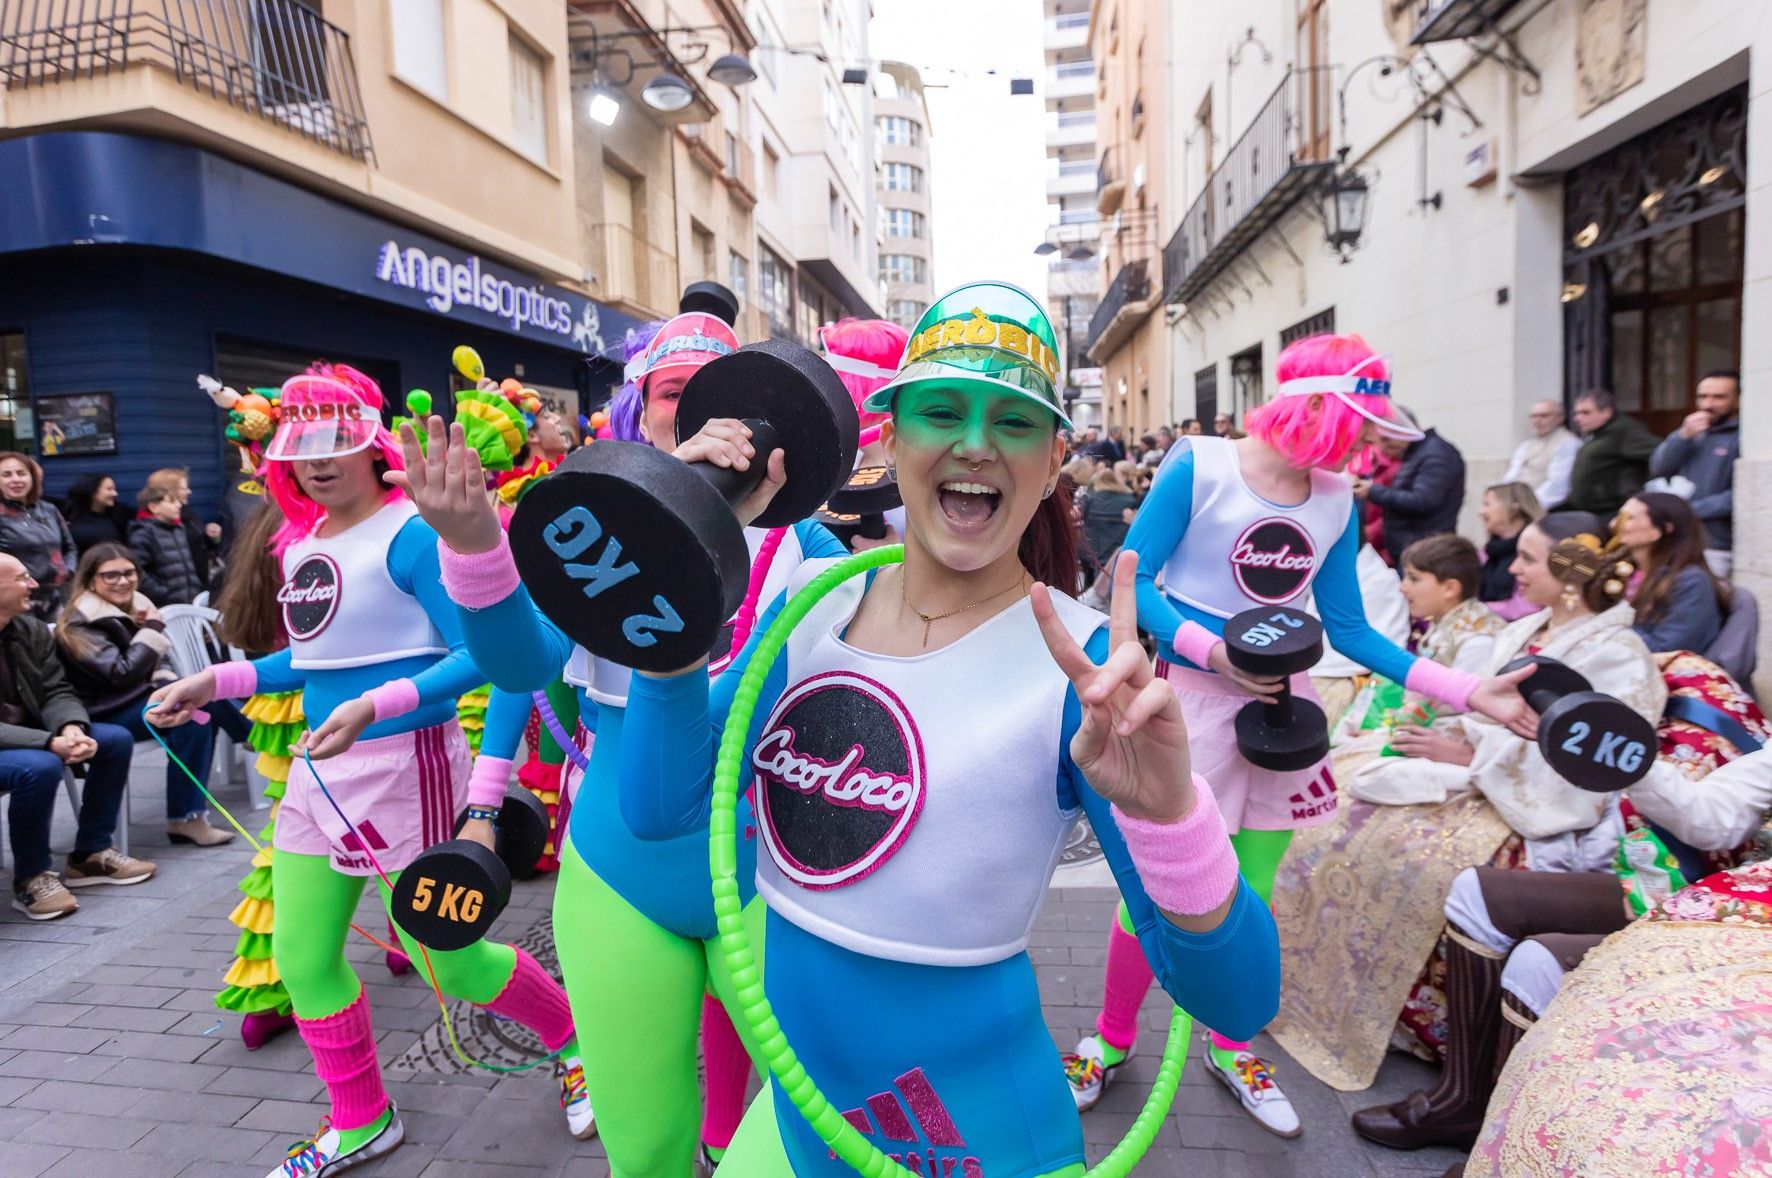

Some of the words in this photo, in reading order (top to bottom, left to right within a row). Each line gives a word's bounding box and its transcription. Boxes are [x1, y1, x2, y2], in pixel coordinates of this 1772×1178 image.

[542, 505, 641, 599] KG
[622, 594, 685, 648] 2
[1240, 622, 1287, 647] KG
[1561, 721, 1591, 755] 2
[1592, 731, 1647, 773] KG
[412, 876, 436, 912] 5
[437, 883, 484, 924] KG
